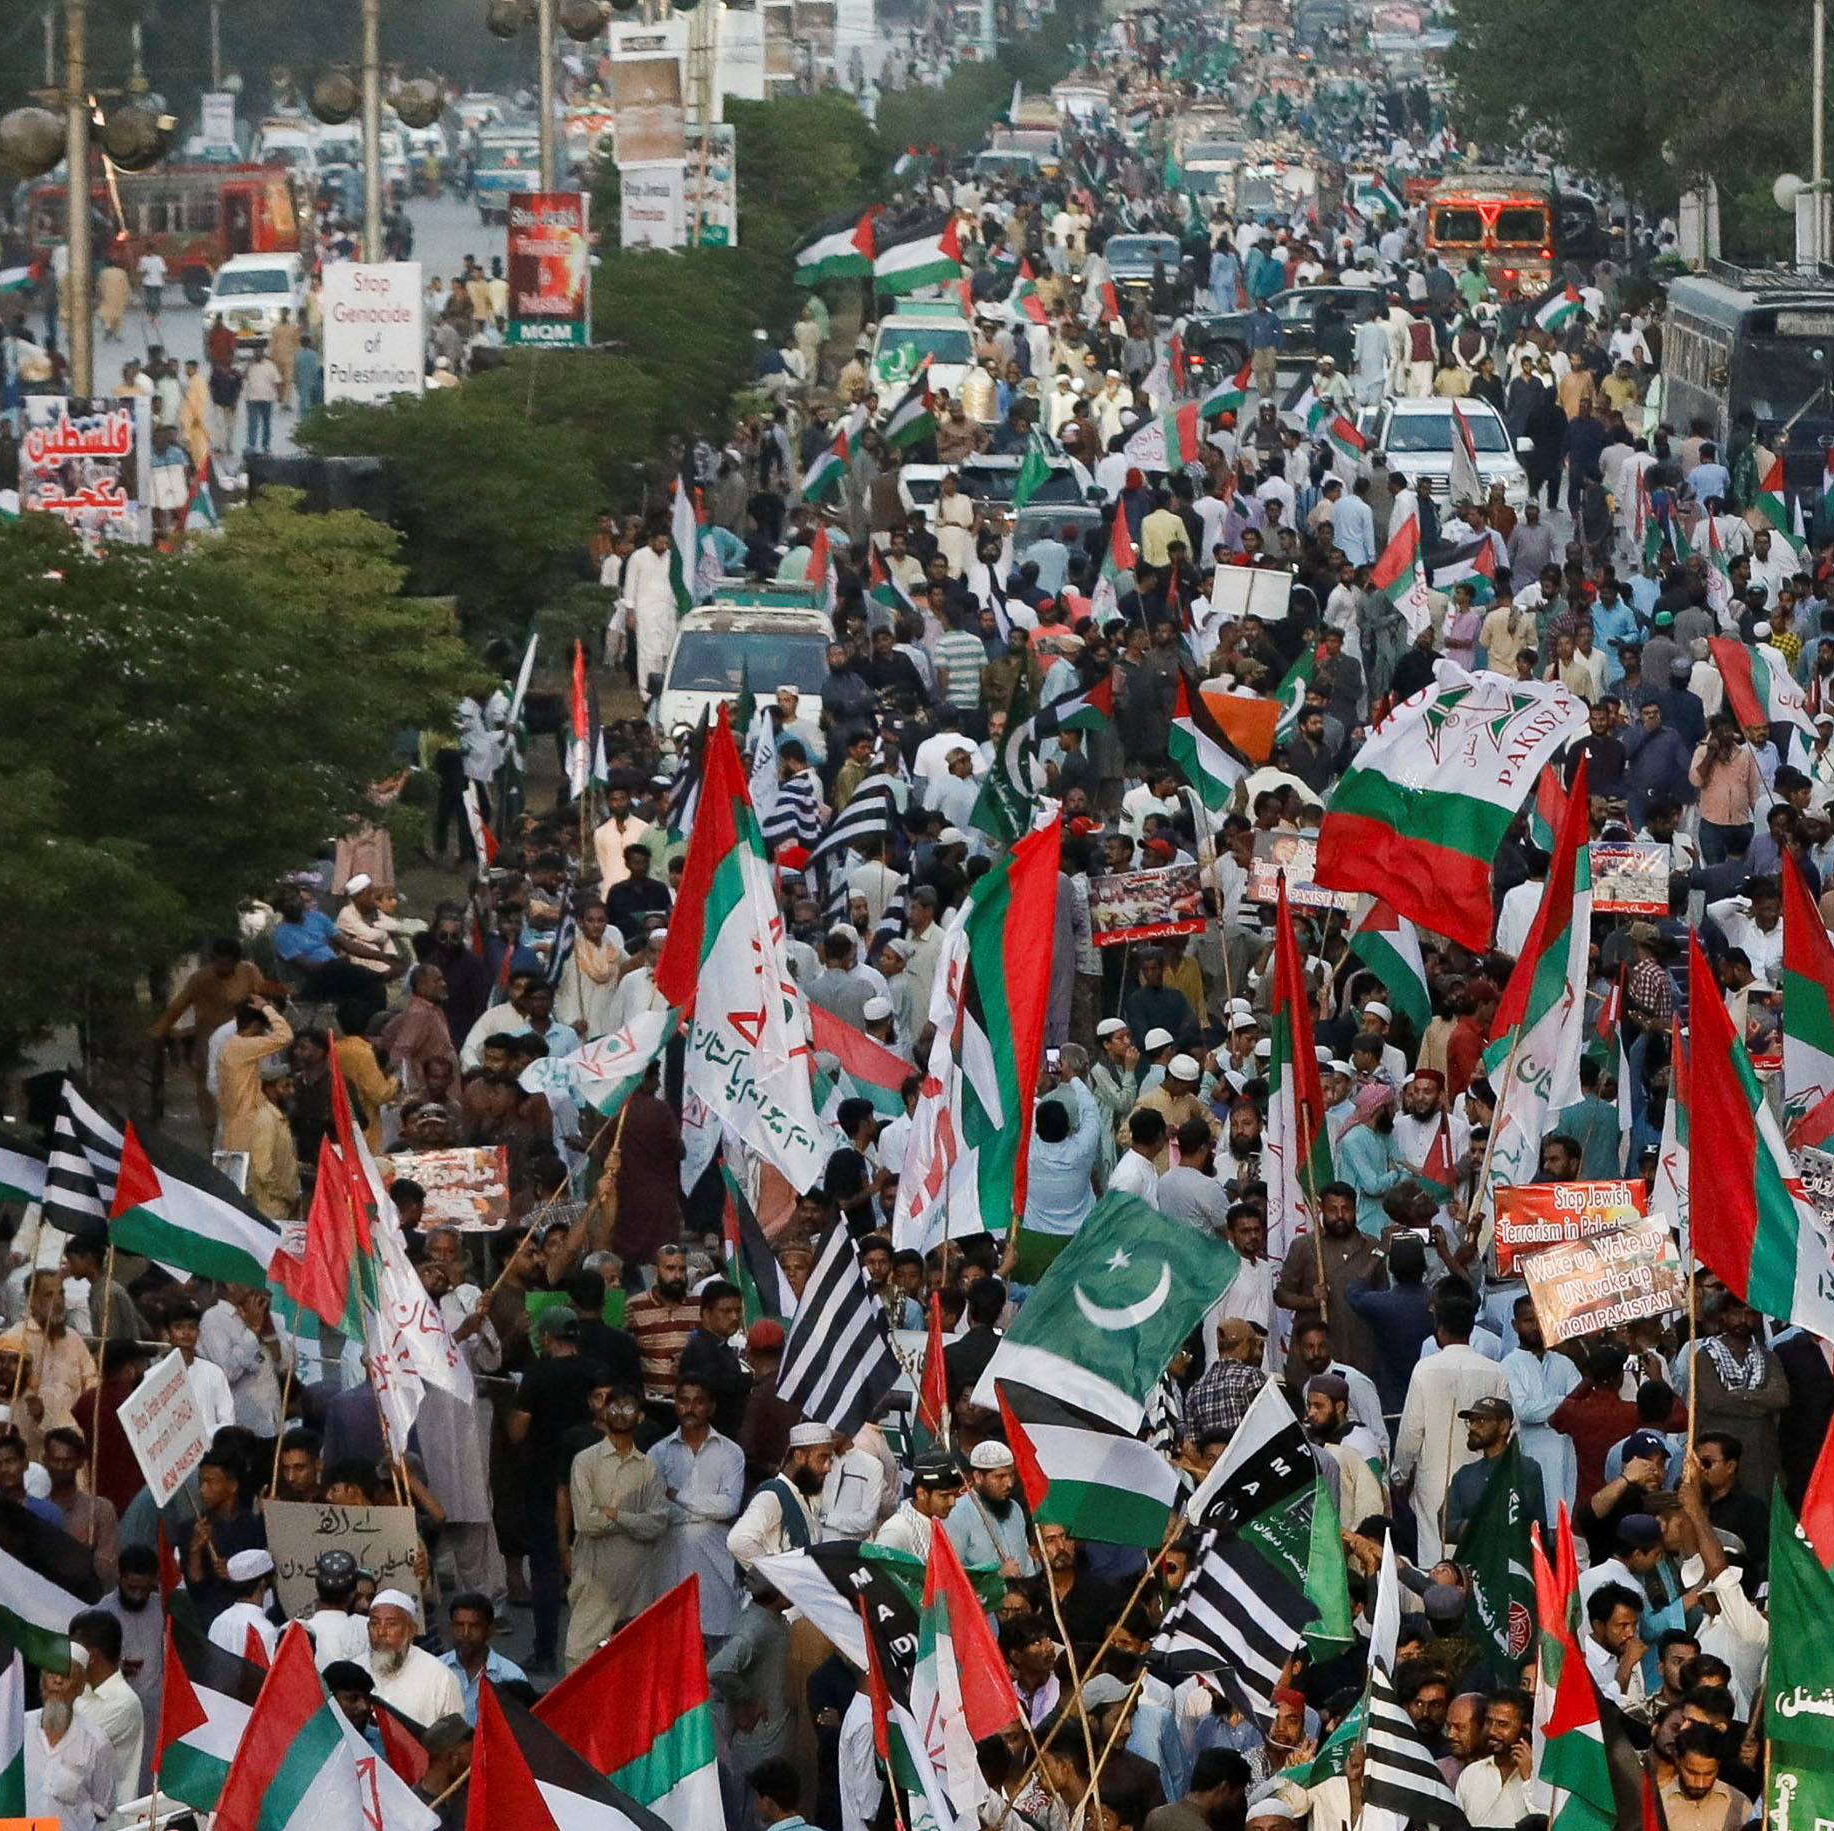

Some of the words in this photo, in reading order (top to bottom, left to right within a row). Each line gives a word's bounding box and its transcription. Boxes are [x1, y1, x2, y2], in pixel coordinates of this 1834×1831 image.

[353, 272, 390, 297] Stop
[333, 300, 411, 324] Genocide
[364, 331, 383, 354] of
[519, 325, 572, 340] MQM
[329, 362, 417, 384] Palestinian
[28, 476, 128, 520] یکجہت
[1554, 1183, 1587, 1212] Stop
[1588, 1182, 1631, 1207] Jewish
[1501, 1218, 1563, 1242] Terrorism
[1564, 1217, 1578, 1241] in
[1527, 1255, 1572, 1282] Wake
[1573, 1249, 1597, 1273] up
[1592, 1234, 1640, 1262] Wake
[1640, 1229, 1664, 1253] up
[1557, 1278, 1585, 1305] UN
[1588, 1274, 1630, 1299] wake
[1630, 1264, 1653, 1290] up
[1556, 1317, 1598, 1339] MQM
[1598, 1291, 1673, 1327] PAKISTAN
